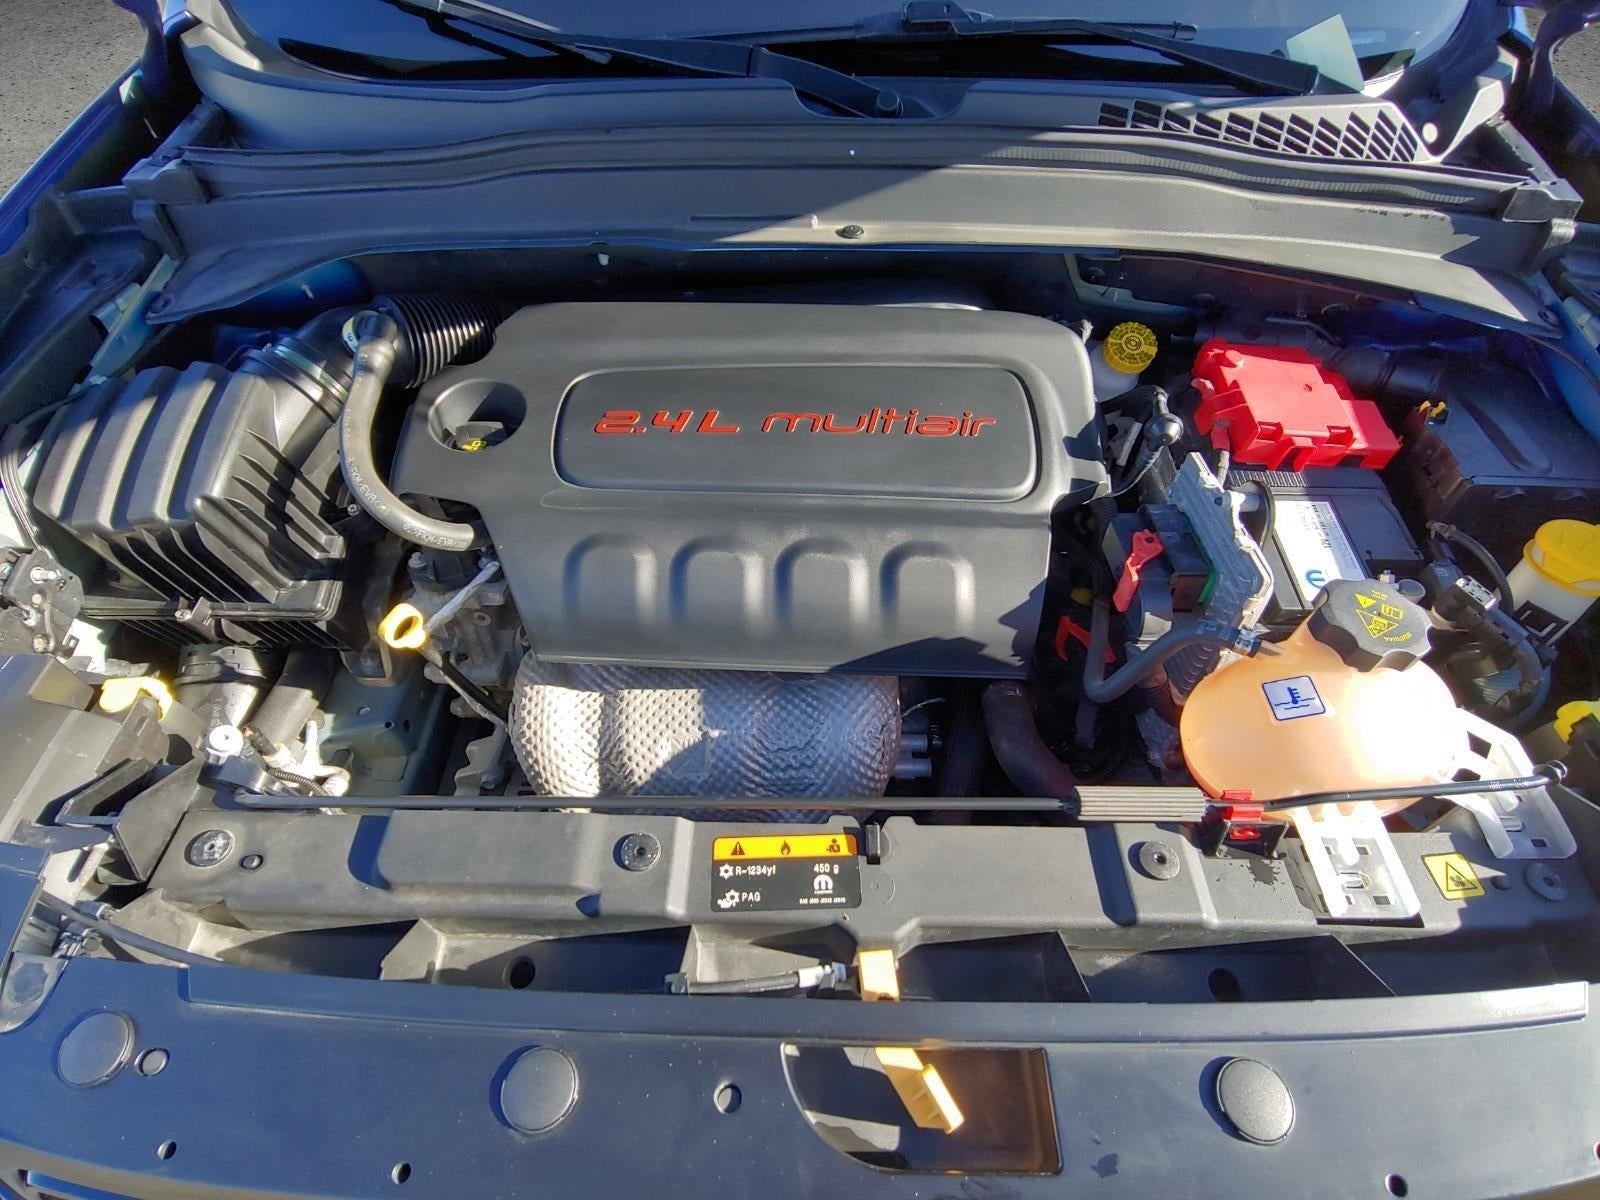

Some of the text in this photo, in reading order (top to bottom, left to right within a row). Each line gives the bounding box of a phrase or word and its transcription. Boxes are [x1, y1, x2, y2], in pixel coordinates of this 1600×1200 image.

[593, 407, 997, 438] 2.4L multiair
[813, 862, 840, 875] 450 g
[741, 891, 761, 902] PAG
